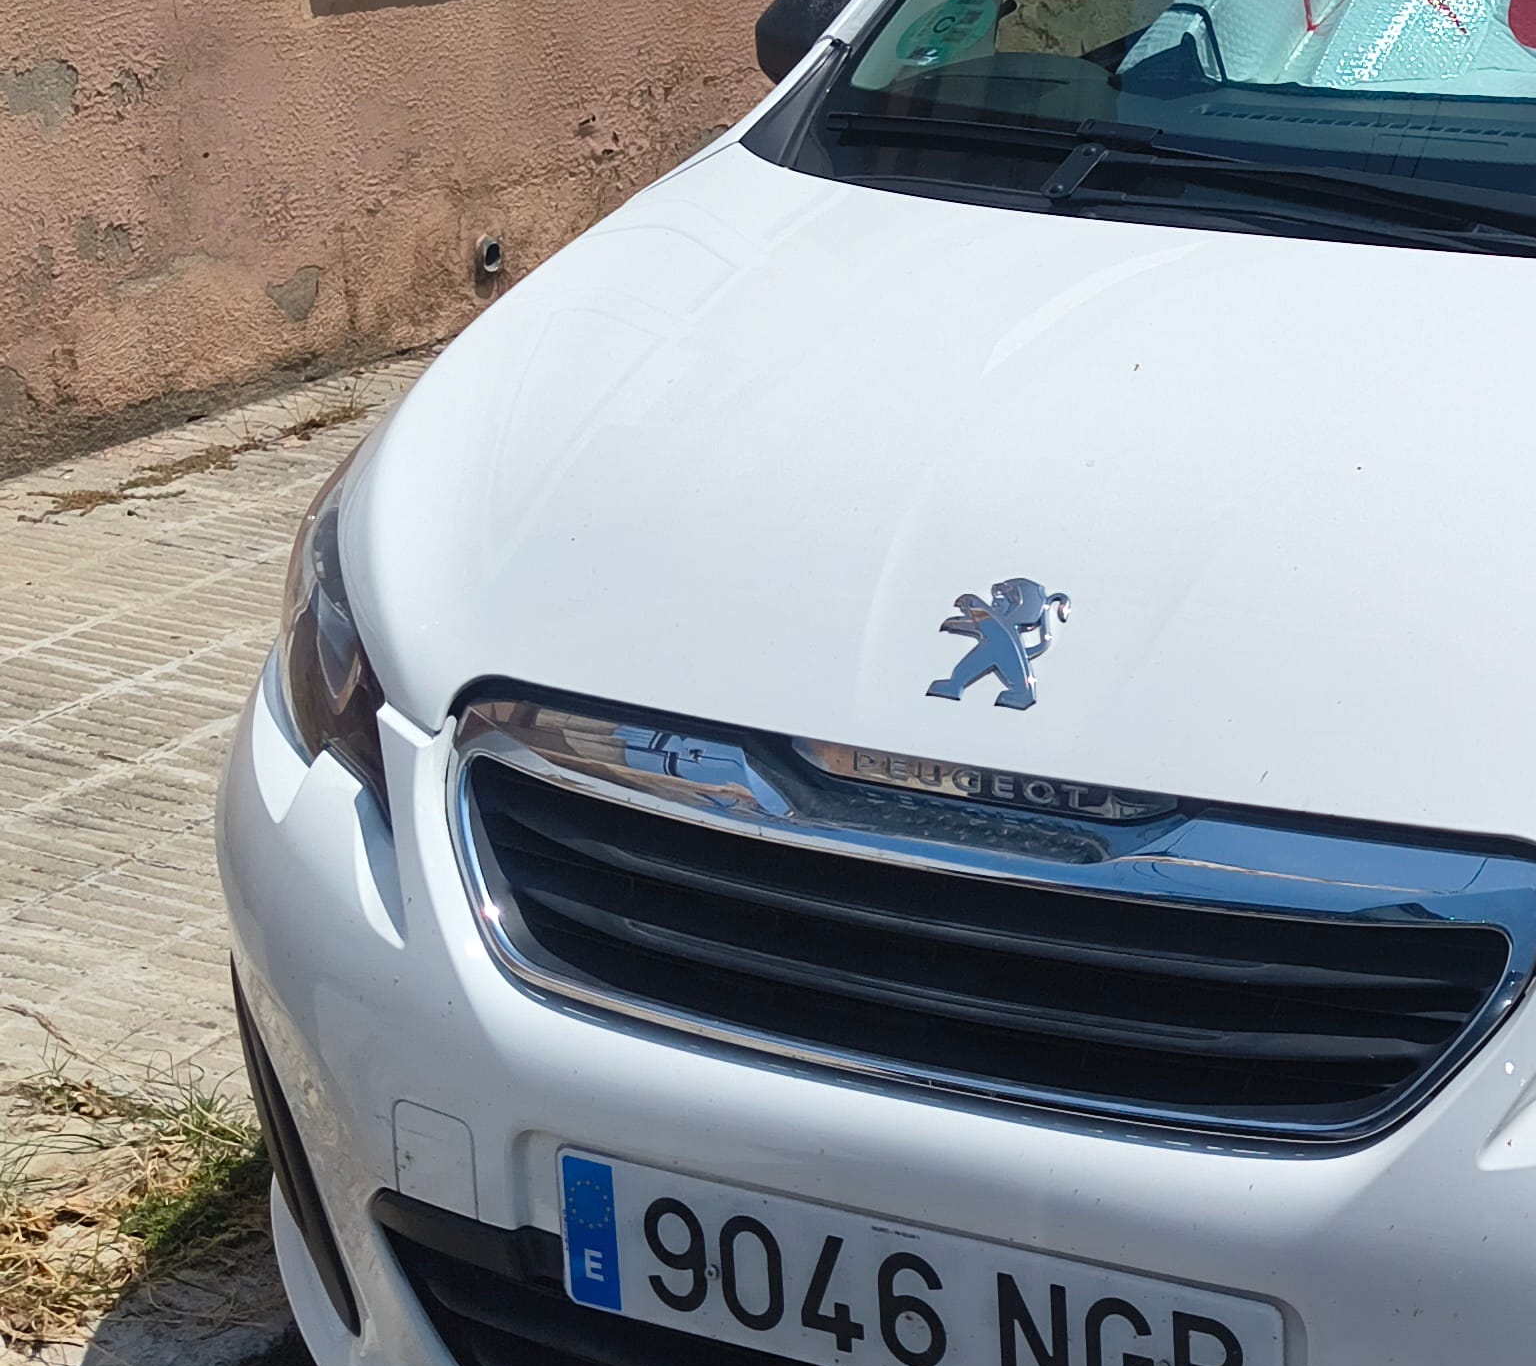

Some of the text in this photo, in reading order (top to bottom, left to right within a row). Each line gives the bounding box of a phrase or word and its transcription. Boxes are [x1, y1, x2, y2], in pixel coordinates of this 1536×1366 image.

[933, 16, 956, 33] C
[852, 750, 1089, 808] PEUGEOT
[584, 1248, 604, 1282] E
